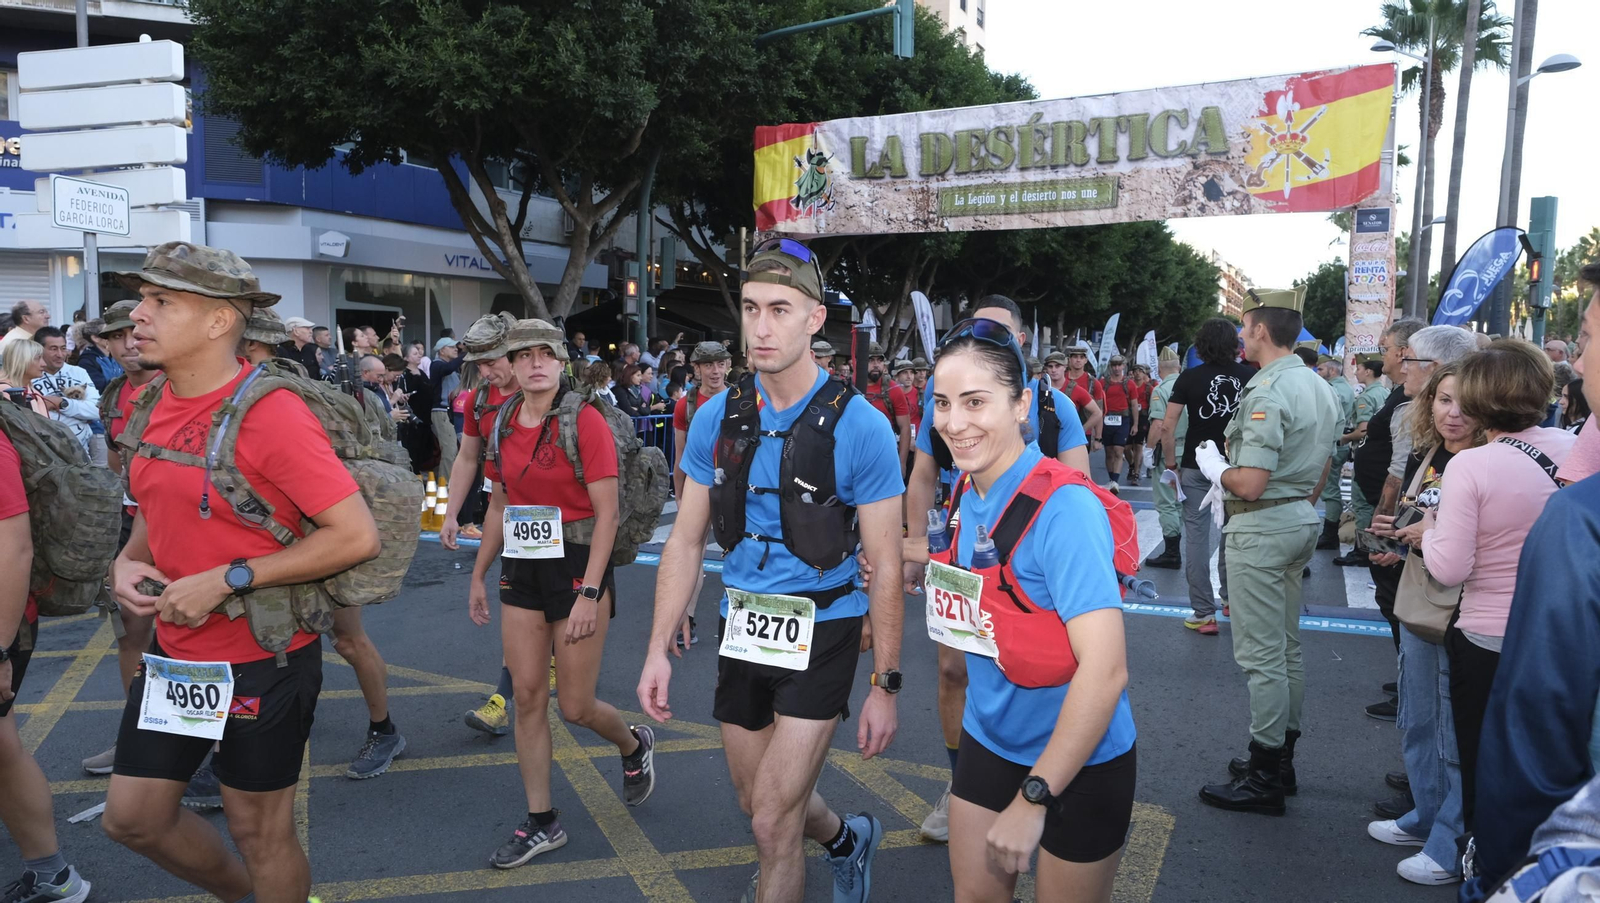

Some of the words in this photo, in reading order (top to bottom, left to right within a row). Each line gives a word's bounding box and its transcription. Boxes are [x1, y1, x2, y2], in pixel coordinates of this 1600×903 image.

[850, 135, 908, 178] LA
[919, 106, 1230, 176] DESÉRTICA
[76, 186, 125, 202] AVENIDA
[954, 192, 964, 205] La
[967, 191, 996, 206] Legión
[1000, 193, 1006, 206] y
[1010, 189, 1018, 202] el
[1022, 188, 1056, 202] desierto
[1061, 189, 1076, 200] nos
[1081, 188, 1097, 200] une
[70, 198, 114, 215] FEDERICO
[59, 210, 94, 226] GARCÍA
[96, 216, 124, 231] LORCA
[1354, 266, 1386, 274] RENTA
[1480, 251, 1513, 286] JUEGA
[33, 377, 81, 396] PARI
[793, 477, 818, 492] EVADICT
[513, 521, 552, 540] 4969
[746, 611, 800, 643] 5270
[1299, 619, 1392, 632] ajama
[166, 680, 221, 710] 4960
